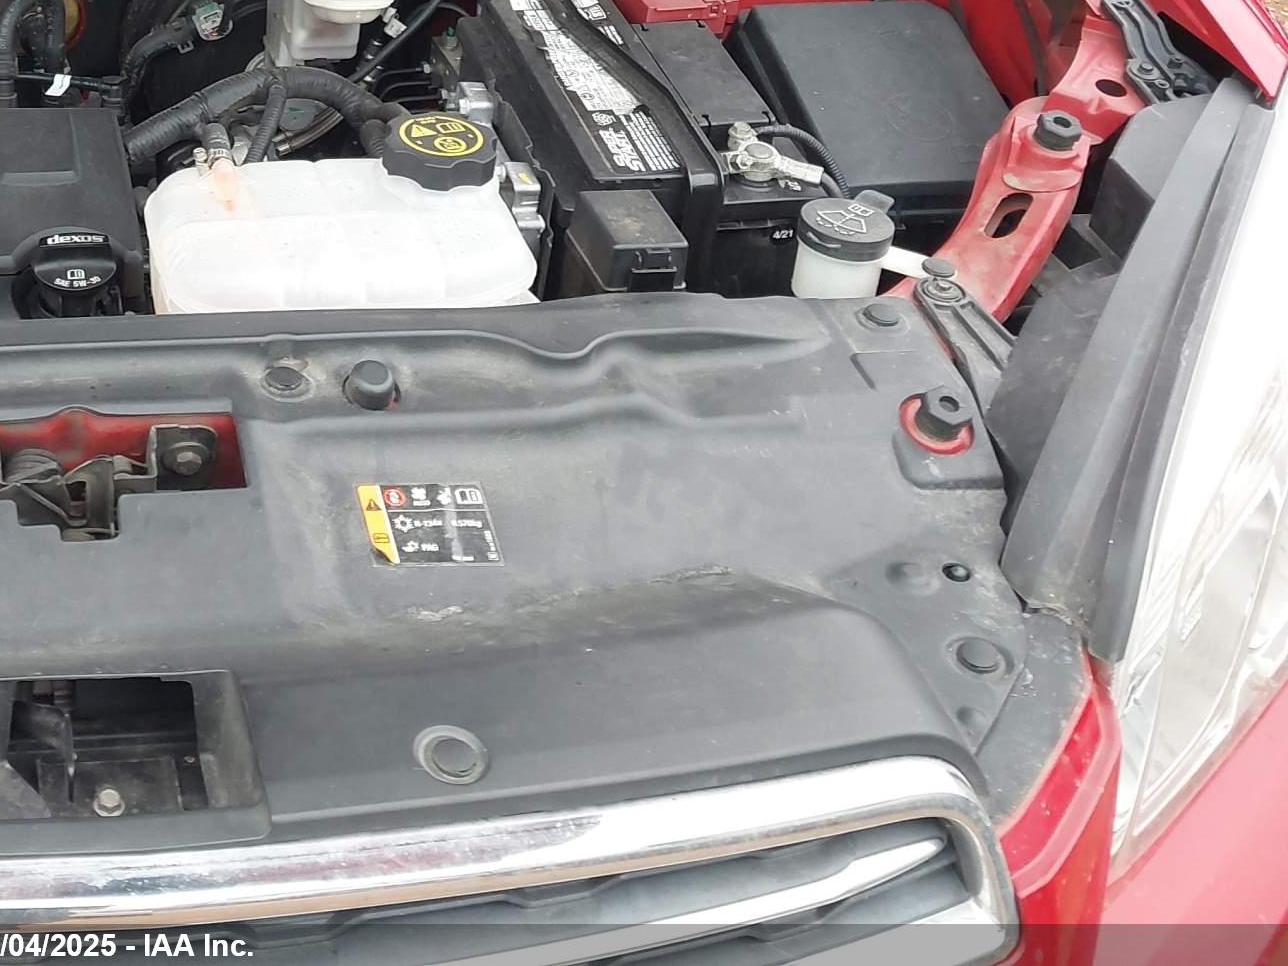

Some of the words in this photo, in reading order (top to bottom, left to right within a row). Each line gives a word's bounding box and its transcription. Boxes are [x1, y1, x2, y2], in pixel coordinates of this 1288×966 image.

[598, 126, 626, 167] SUPER
[613, 129, 647, 172] START
[46, 234, 105, 245] dexos
[772, 229, 794, 240] 4/21
[53, 277, 72, 288] SAE
